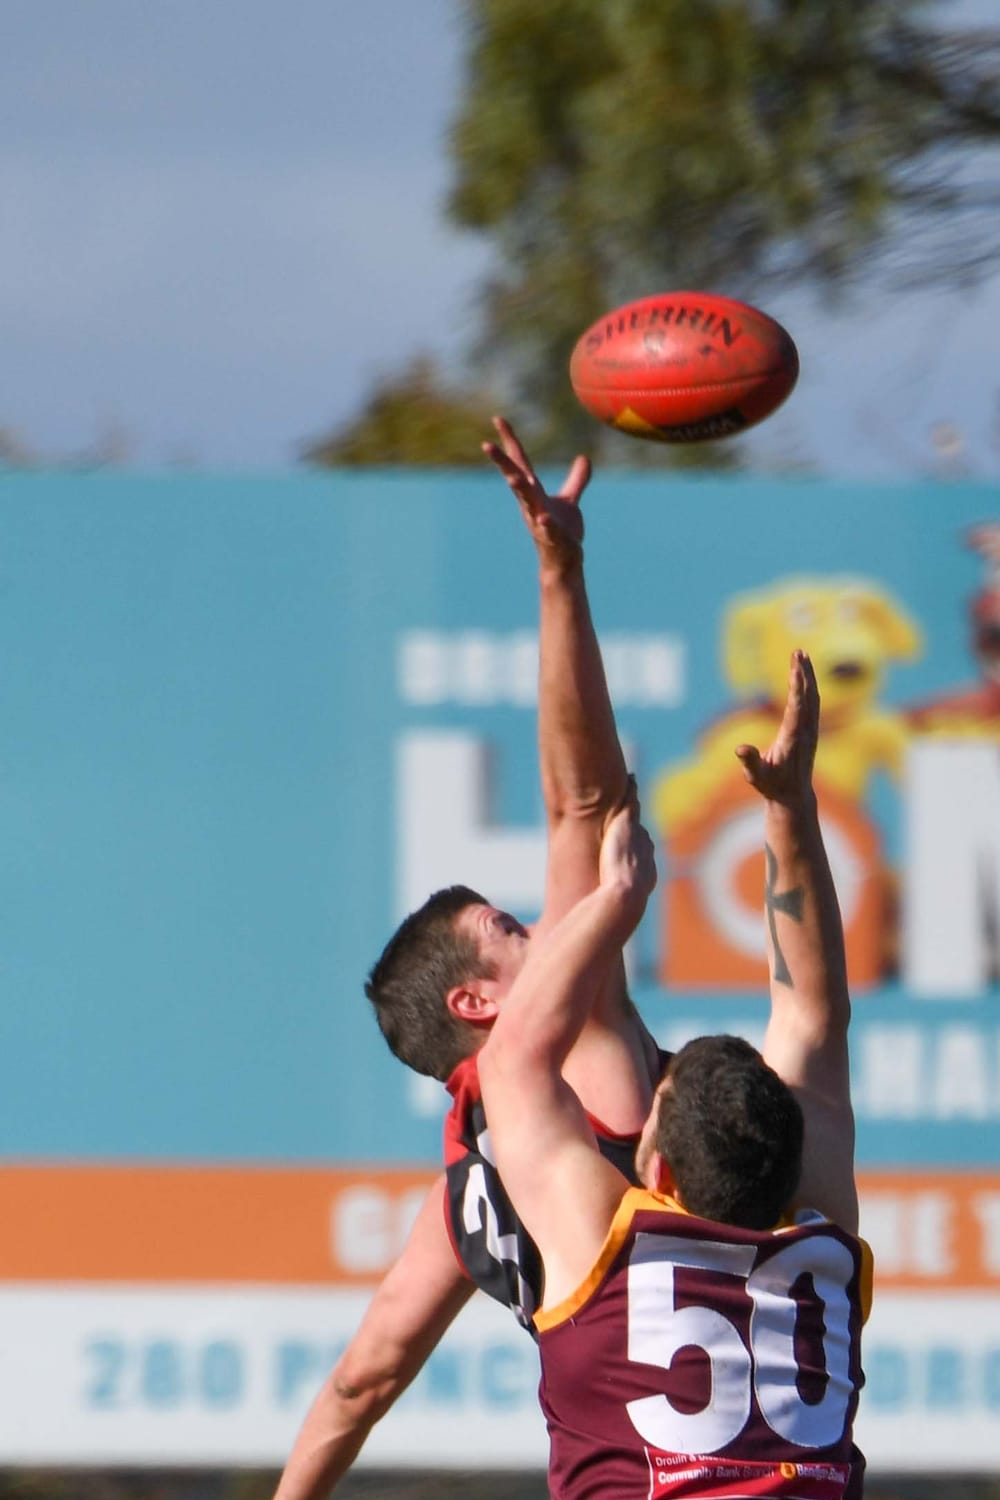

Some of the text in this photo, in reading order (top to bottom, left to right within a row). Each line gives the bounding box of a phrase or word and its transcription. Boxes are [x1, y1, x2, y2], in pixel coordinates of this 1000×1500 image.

[626, 1231, 856, 1454] 50
[83, 1334, 245, 1410] 280
[655, 1454, 687, 1467] Drouin
[658, 1466, 713, 1485] Community
[716, 1465, 740, 1479] Bank
